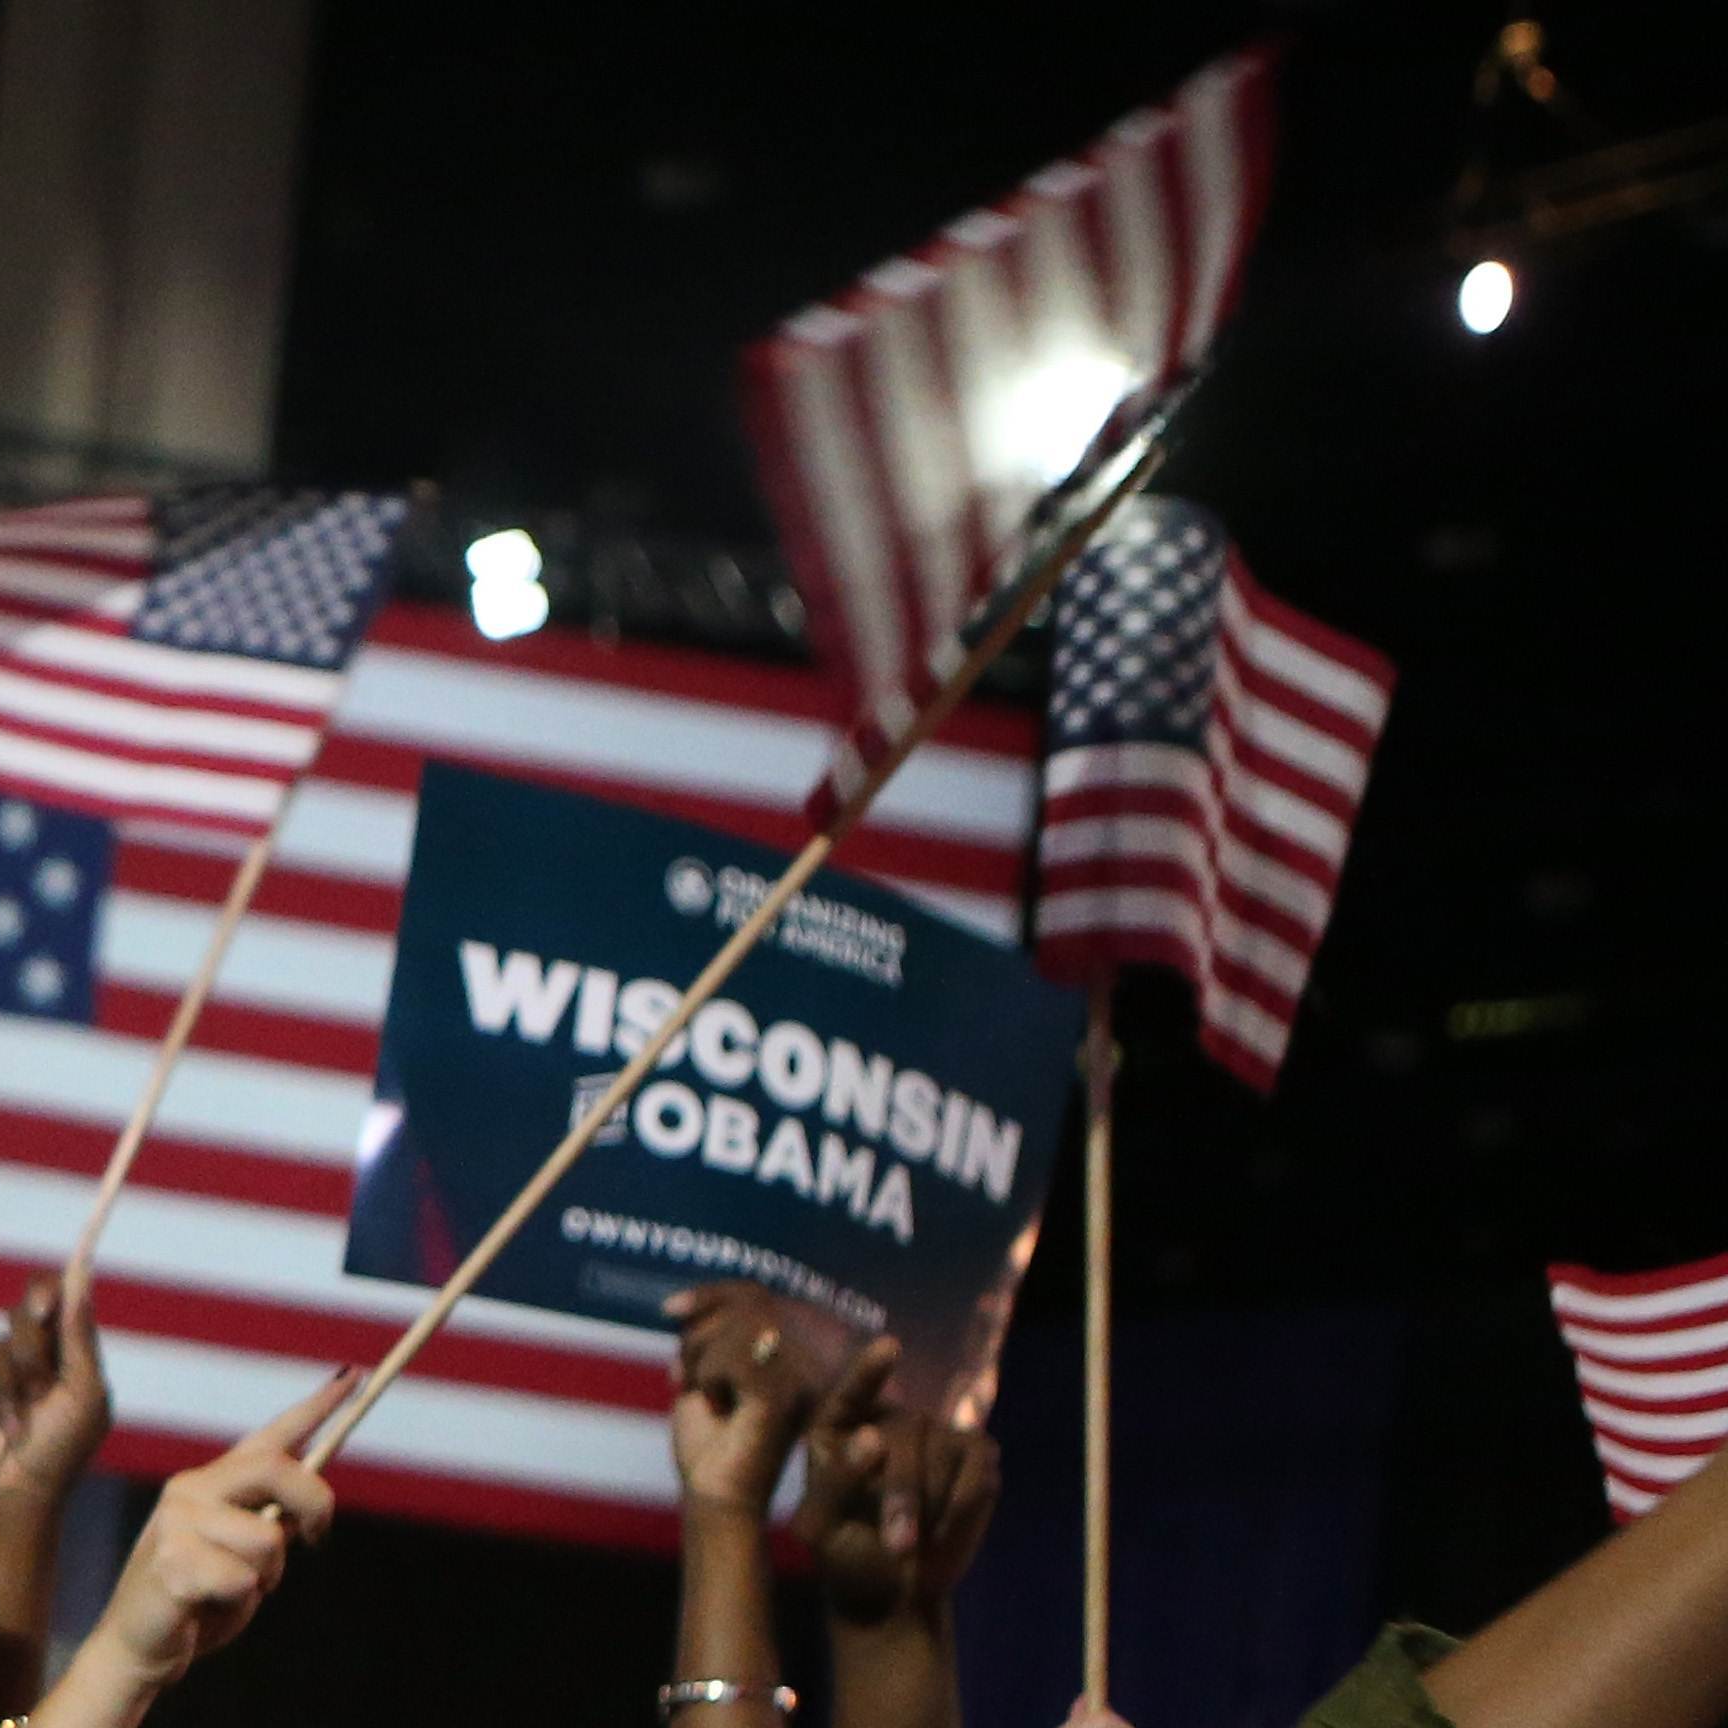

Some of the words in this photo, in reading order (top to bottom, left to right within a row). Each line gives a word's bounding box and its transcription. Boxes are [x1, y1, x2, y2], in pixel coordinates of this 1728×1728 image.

[716, 864, 907, 957] ORANIZING
[458, 938, 1024, 1206] WISCONSIN
[633, 1079, 915, 1246] OBAMA
